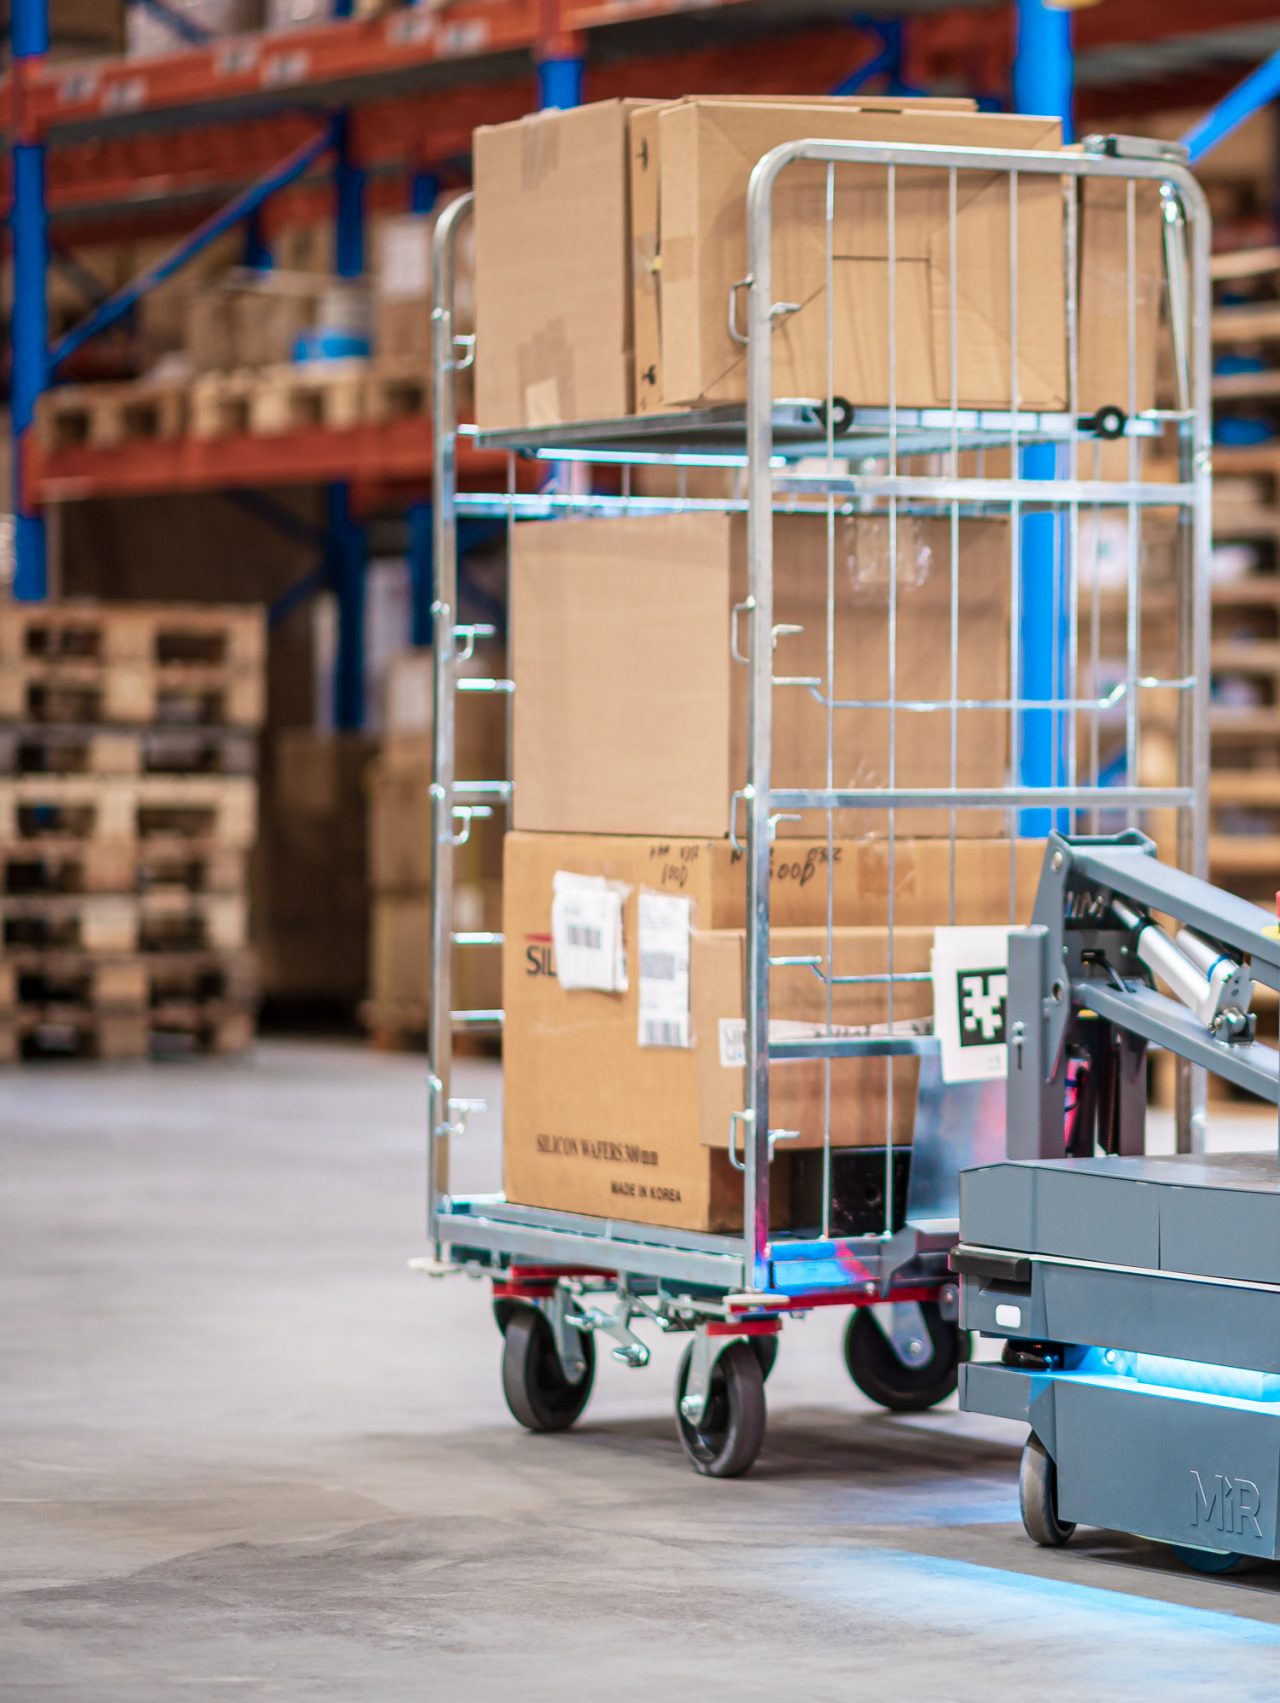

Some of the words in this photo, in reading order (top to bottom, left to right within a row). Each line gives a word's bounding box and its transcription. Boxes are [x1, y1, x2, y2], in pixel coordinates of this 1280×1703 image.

[526, 945, 557, 976] SIL
[537, 1134, 578, 1156] SILICON
[580, 1138, 623, 1162] WAFERS
[611, 1181, 635, 1197] MADE
[638, 1184, 648, 1198] IN
[650, 1186, 682, 1202] KOREA
[1190, 1470, 1263, 1538] MiR
